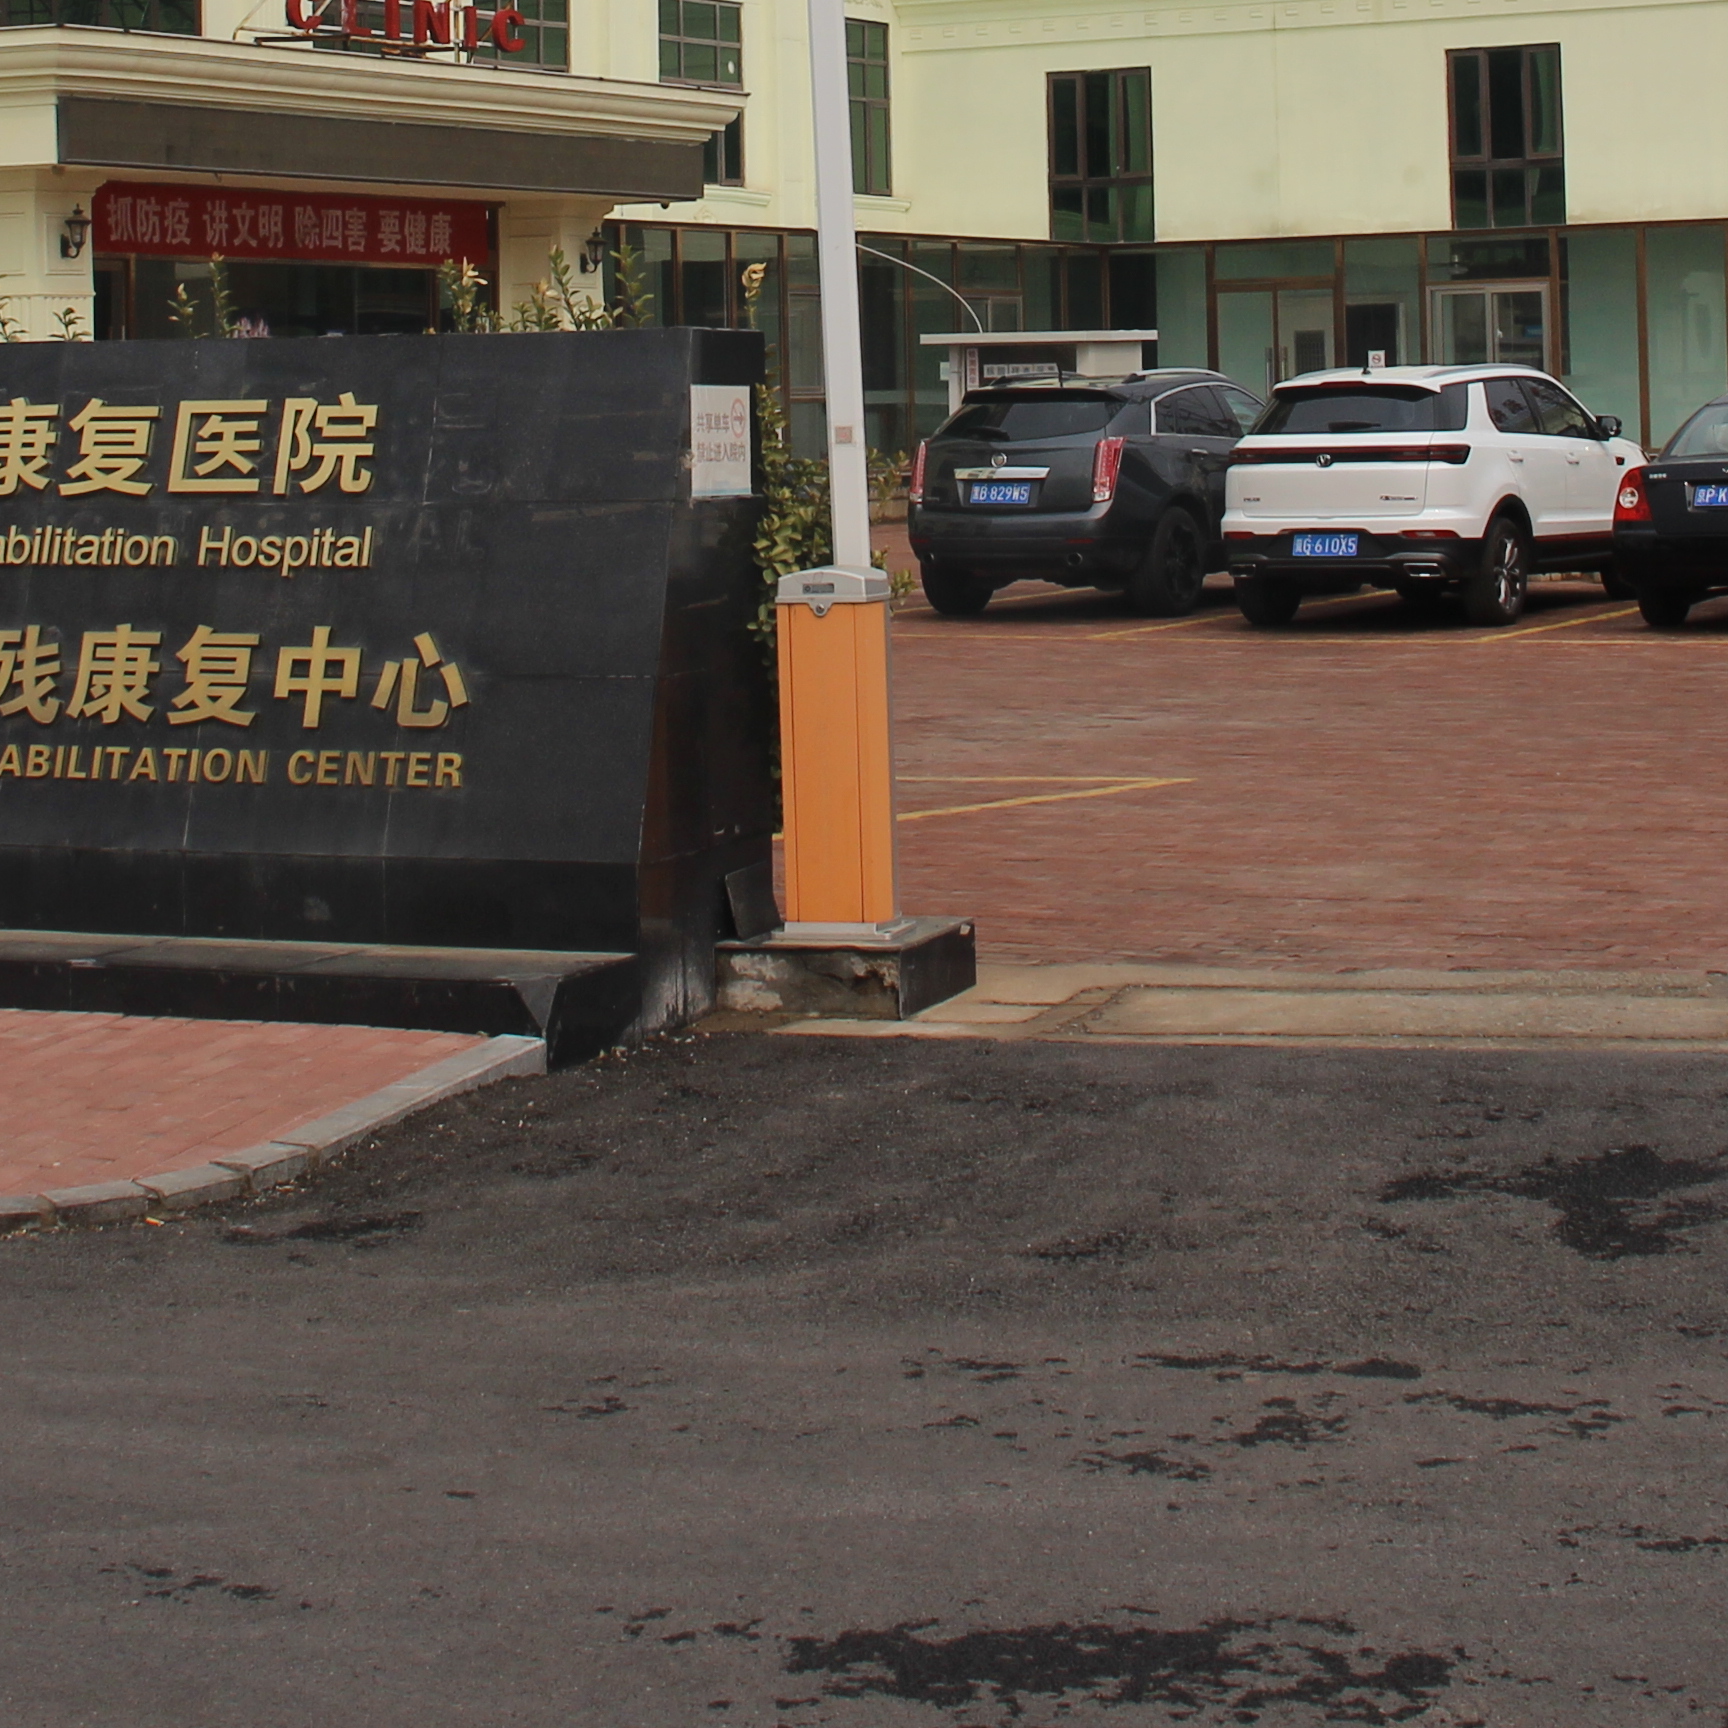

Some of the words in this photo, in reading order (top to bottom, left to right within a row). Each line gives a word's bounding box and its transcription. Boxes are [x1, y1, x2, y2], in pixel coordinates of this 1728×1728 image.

[106, 193, 193, 245] 抓防疫
[202, 200, 284, 249] 讲文明
[293, 203, 369, 254] 除四害
[376, 208, 454, 257] 要健康
[197, 525, 374, 576] Hospital
[286, 748, 465, 789] CENTER
